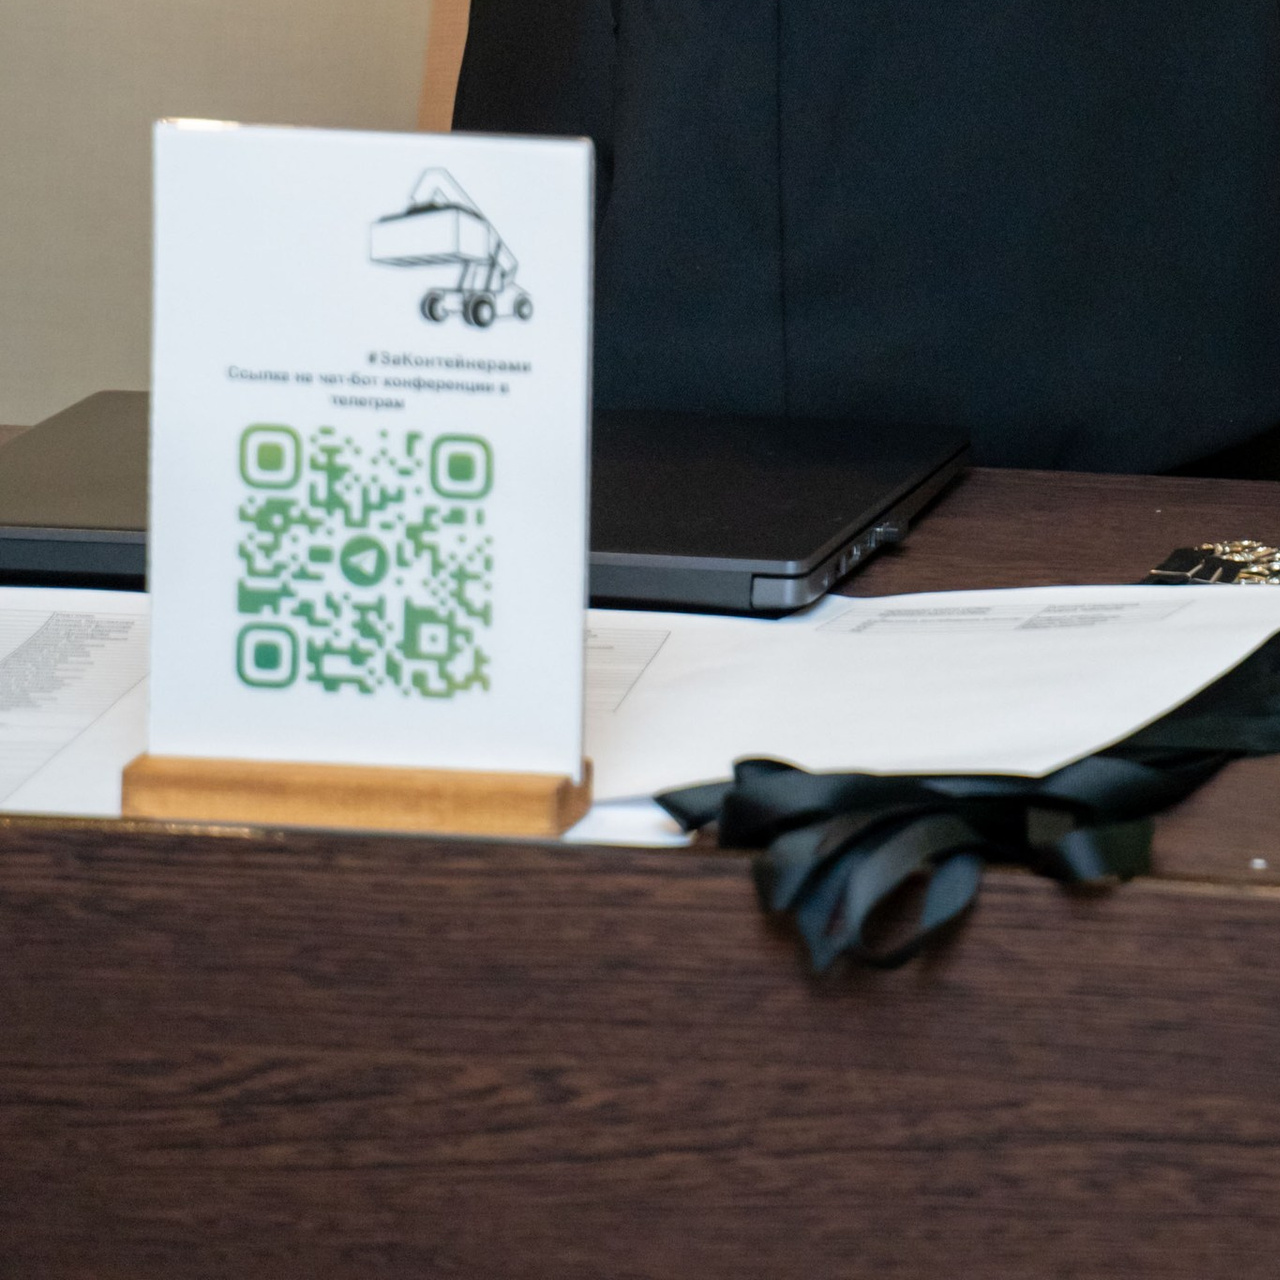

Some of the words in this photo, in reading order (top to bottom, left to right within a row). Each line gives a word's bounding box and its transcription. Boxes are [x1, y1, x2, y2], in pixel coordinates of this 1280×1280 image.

[227, 365, 290, 382] Ссылка
[295, 371, 314, 383] на
[319, 371, 378, 386] чат-бот
[383, 376, 495, 393] конференции
[331, 393, 406, 410] телеграм
